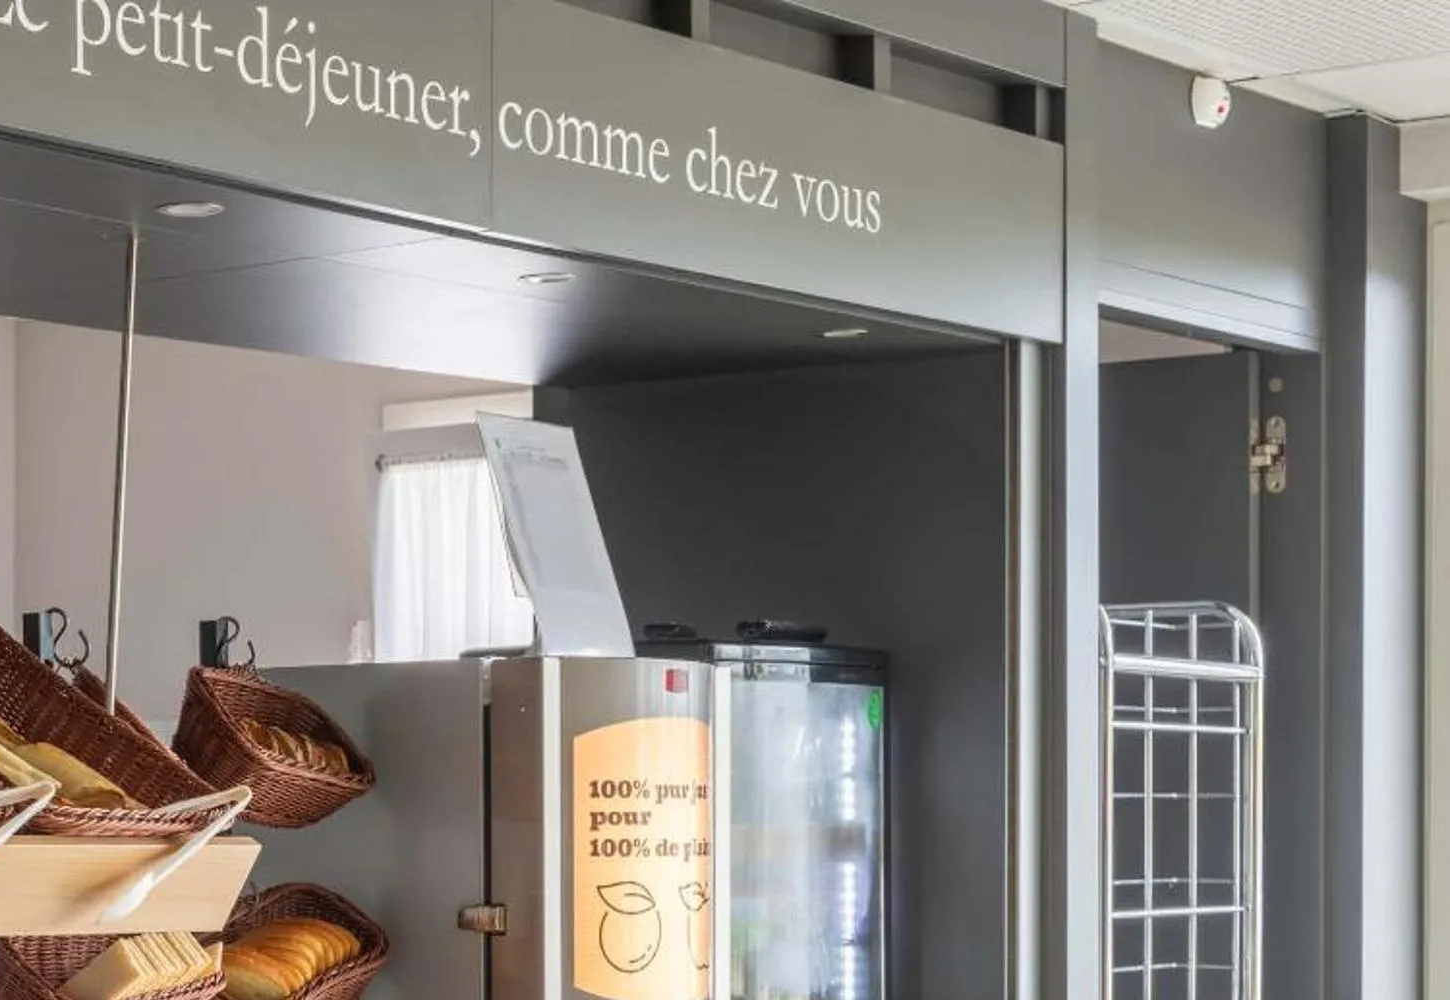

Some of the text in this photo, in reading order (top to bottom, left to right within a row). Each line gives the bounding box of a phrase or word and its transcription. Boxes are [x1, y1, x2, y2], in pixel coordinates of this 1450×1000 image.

[71, 0, 481, 156] petit-déjeuner,
[498, 101, 670, 184] comme
[685, 126, 779, 210] chez
[791, 172, 882, 234] vous
[588, 779, 650, 799] 100%
[654, 784, 689, 804] pur
[589, 811, 652, 831] pour
[588, 838, 650, 858] 100%
[654, 838, 680, 857] de
